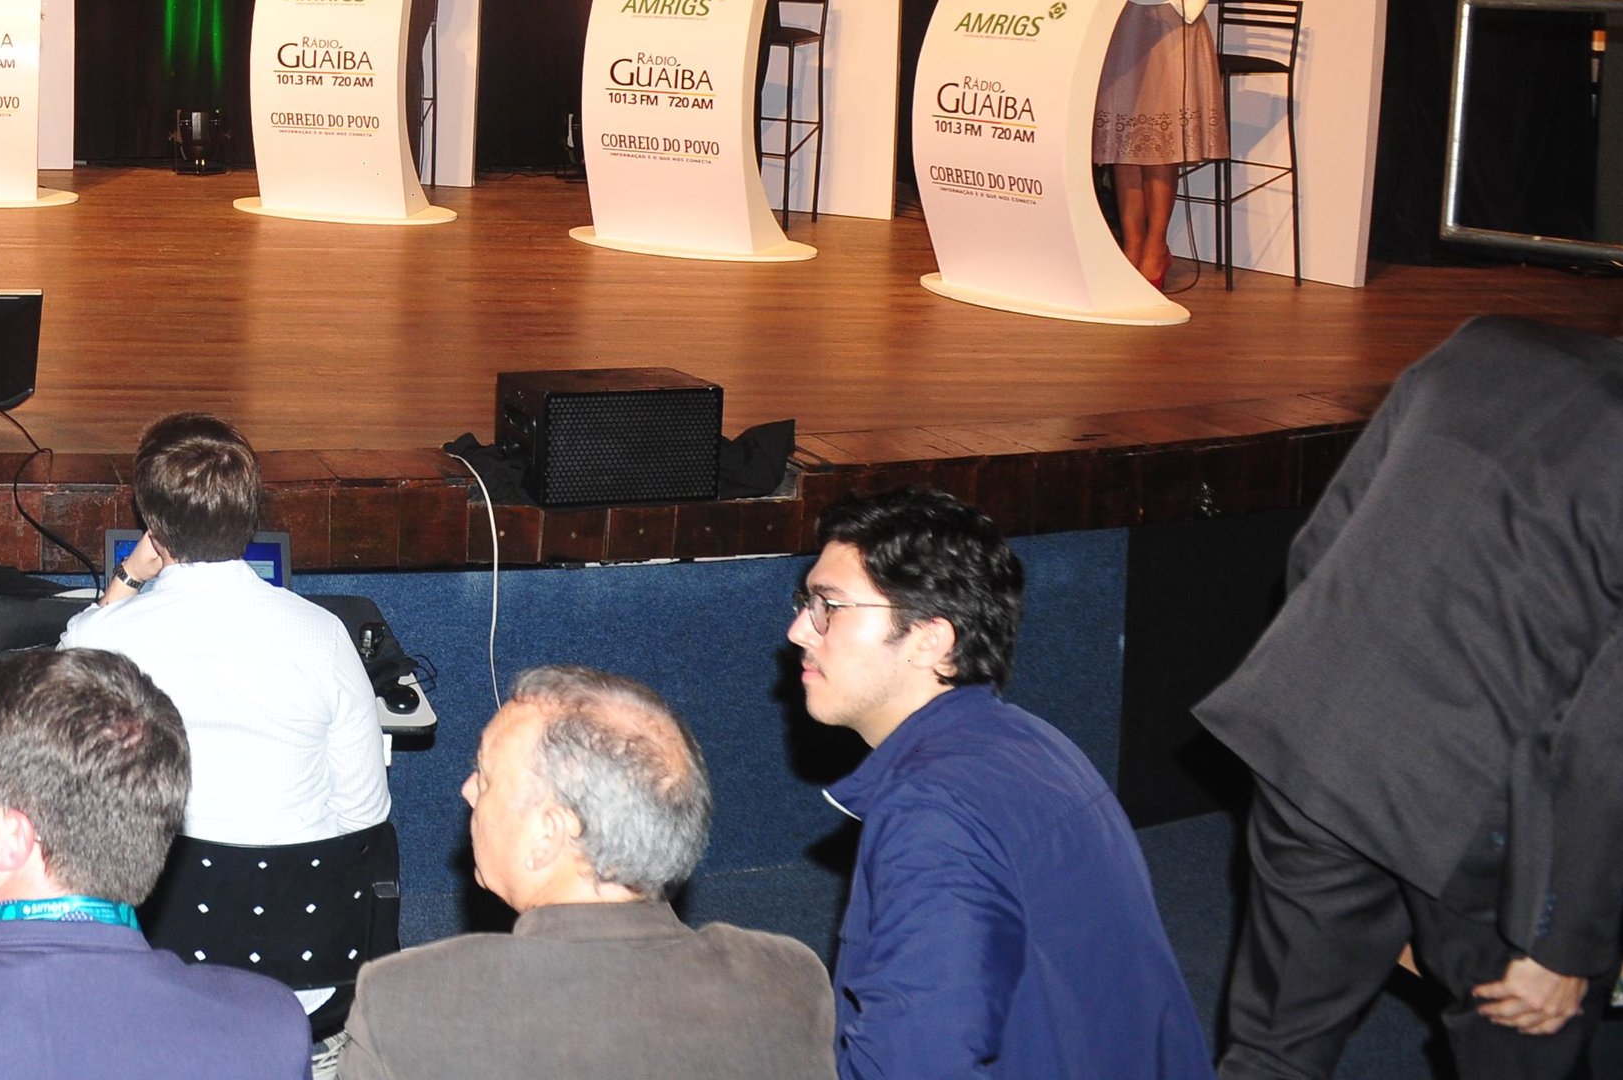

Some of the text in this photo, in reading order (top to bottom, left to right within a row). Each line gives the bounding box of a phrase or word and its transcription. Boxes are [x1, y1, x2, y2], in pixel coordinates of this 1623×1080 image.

[954, 12, 1044, 37] AMRIGS
[302, 37, 339, 48] RÁDIO
[277, 43, 372, 70] GUAÍBA
[637, 52, 677, 66] RÁDIO
[277, 75, 373, 87] 101.3 FM 720 AM
[610, 59, 713, 91] GUAÍBA
[964, 76, 1002, 93] RÁDIO
[608, 92, 713, 110] 101.3 FM 720 AM
[937, 83, 1035, 122] GUAÍBA
[271, 112, 379, 129] CORREIO DO POVO
[935, 120, 1035, 143] 101.3 FM 720 AM
[601, 133, 719, 155] CORREIO DO POVO
[930, 166, 1042, 195] CORREIO DO POVO
